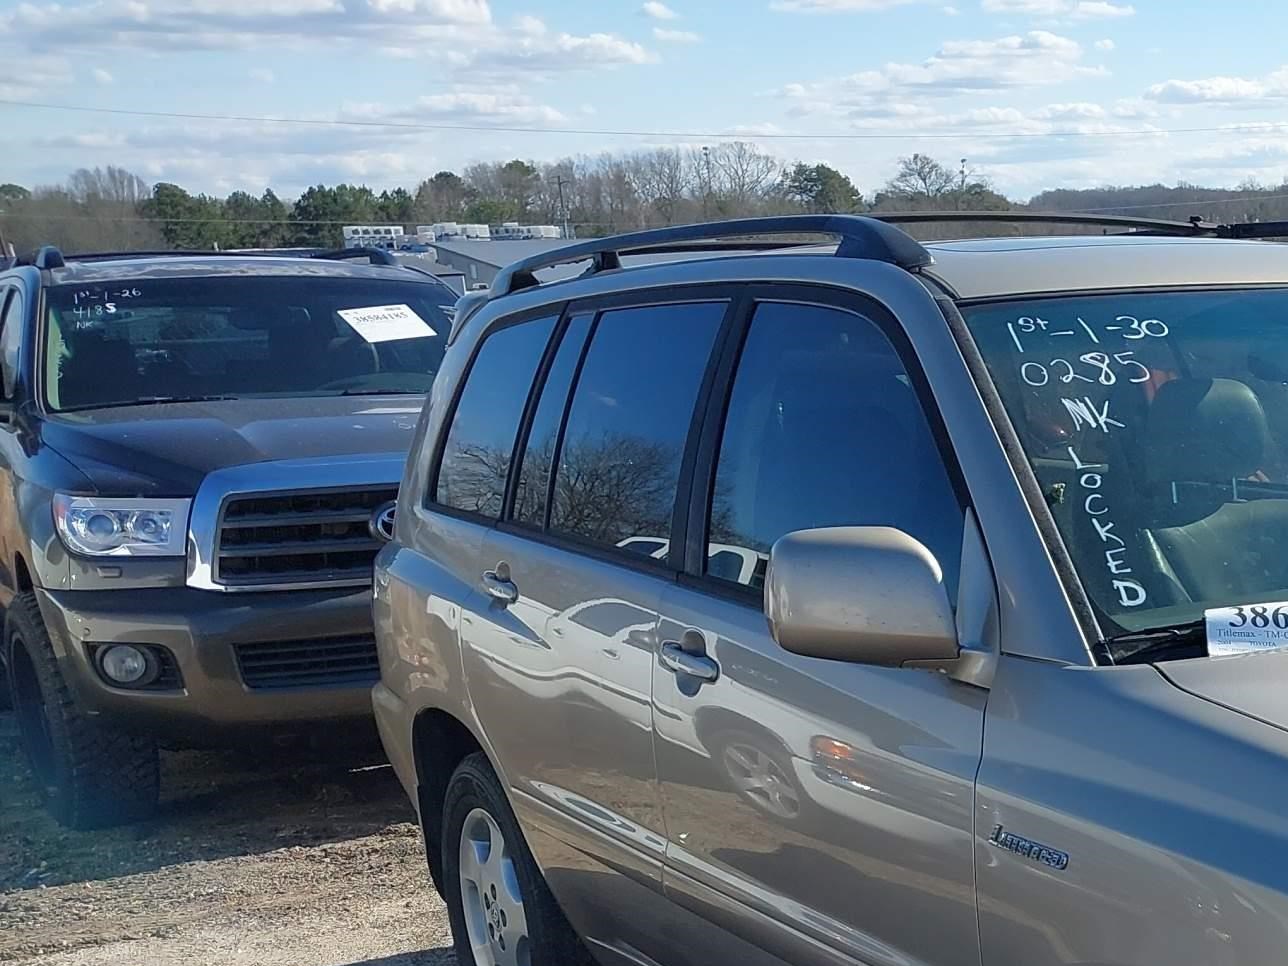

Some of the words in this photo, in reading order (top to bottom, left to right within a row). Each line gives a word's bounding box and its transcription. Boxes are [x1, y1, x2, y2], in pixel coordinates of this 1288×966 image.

[73, 302, 117, 319] 4185
[1020, 351, 1151, 387] 0285
[1060, 396, 1126, 433] NK
[1067, 446, 1147, 608] LOCKED
[1216, 628, 1257, 639] Titlemax
[1249, 639, 1277, 647] TOYOTA
